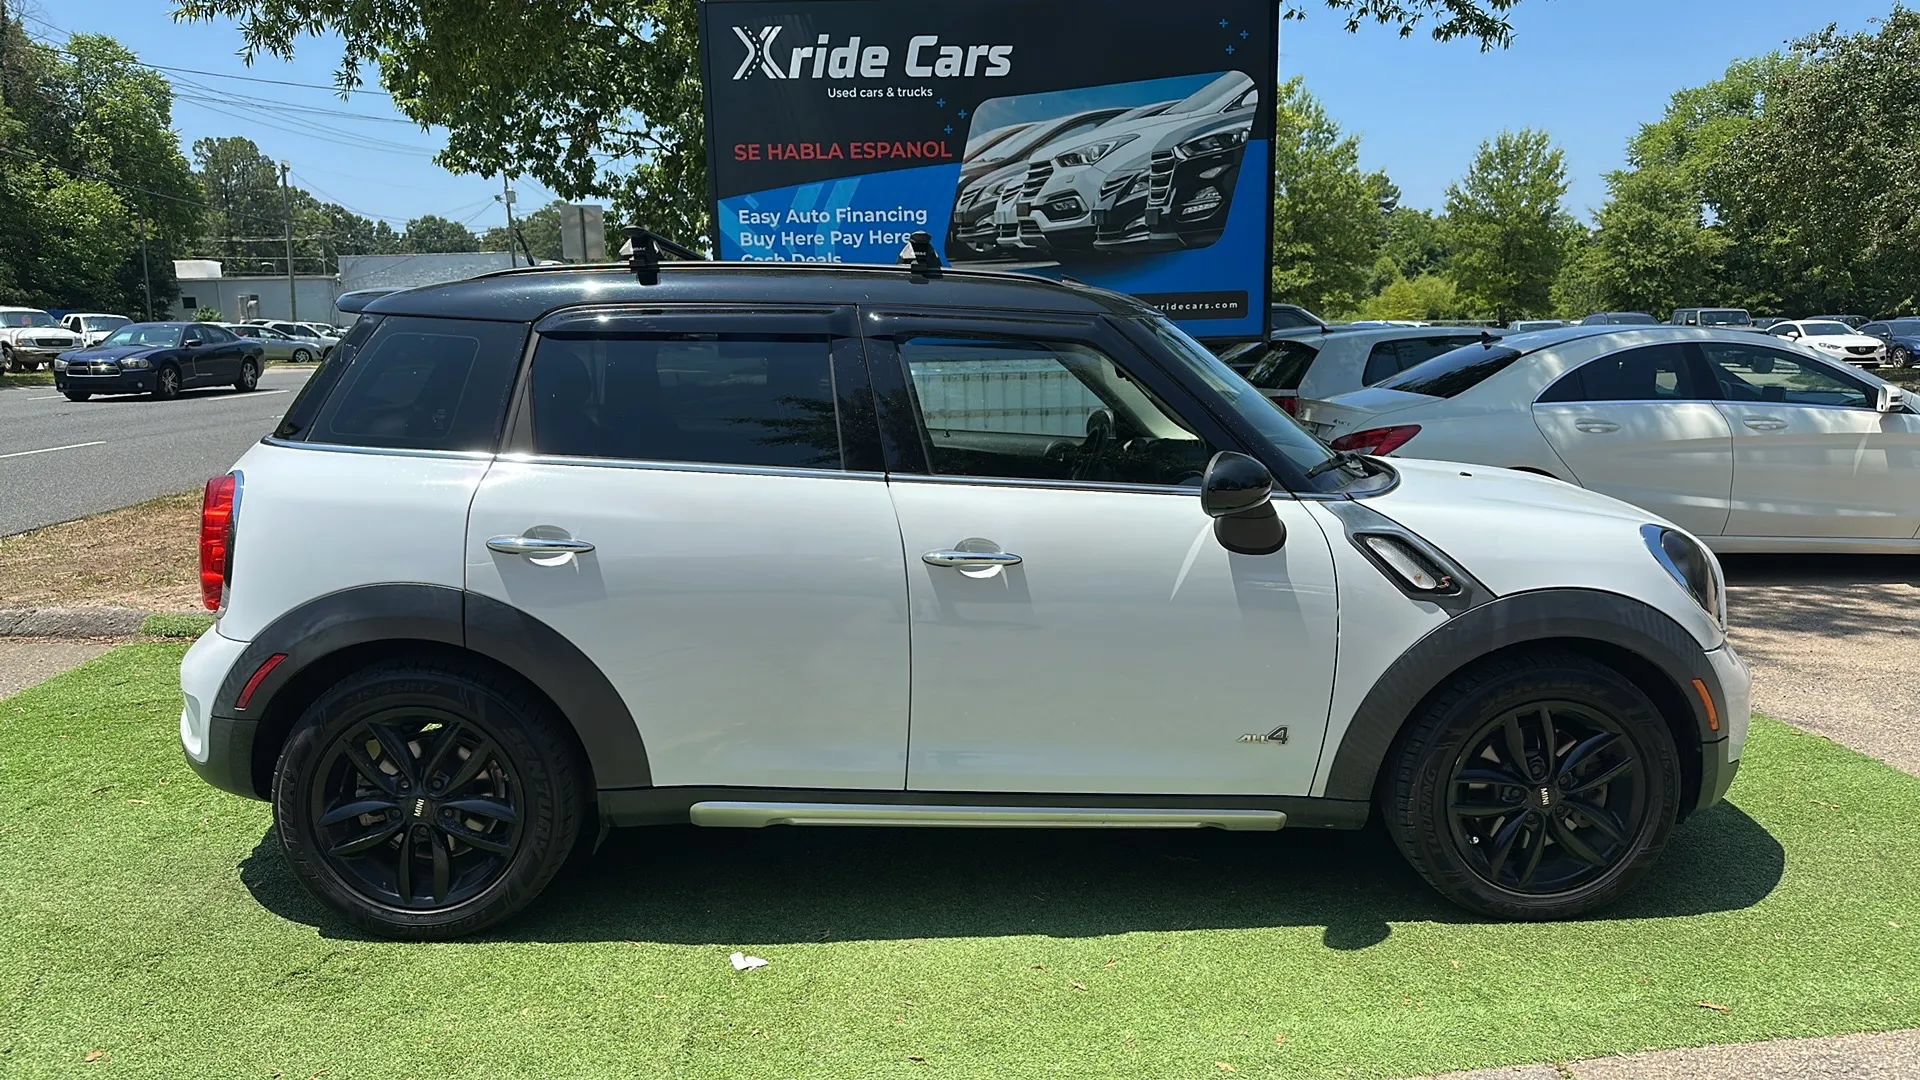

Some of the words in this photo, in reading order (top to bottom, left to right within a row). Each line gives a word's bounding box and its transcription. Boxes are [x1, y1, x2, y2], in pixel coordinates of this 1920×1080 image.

[905, 35, 1013, 78] Cars
[828, 87, 857, 98] Used
[860, 88, 883, 98] cars
[886, 88, 895, 97] &
[898, 86, 933, 97] trucks
[735, 144, 760, 160] SE
[768, 143, 844, 160] HABLA
[850, 141, 952, 159] ESPANOL
[739, 209, 781, 227] Easy
[786, 209, 830, 224] Auto
[836, 207, 927, 225] Financing
[740, 232, 775, 249] Buy
[781, 231, 824, 246] Here
[830, 230, 863, 247] Pay
[870, 229, 911, 245] Here
